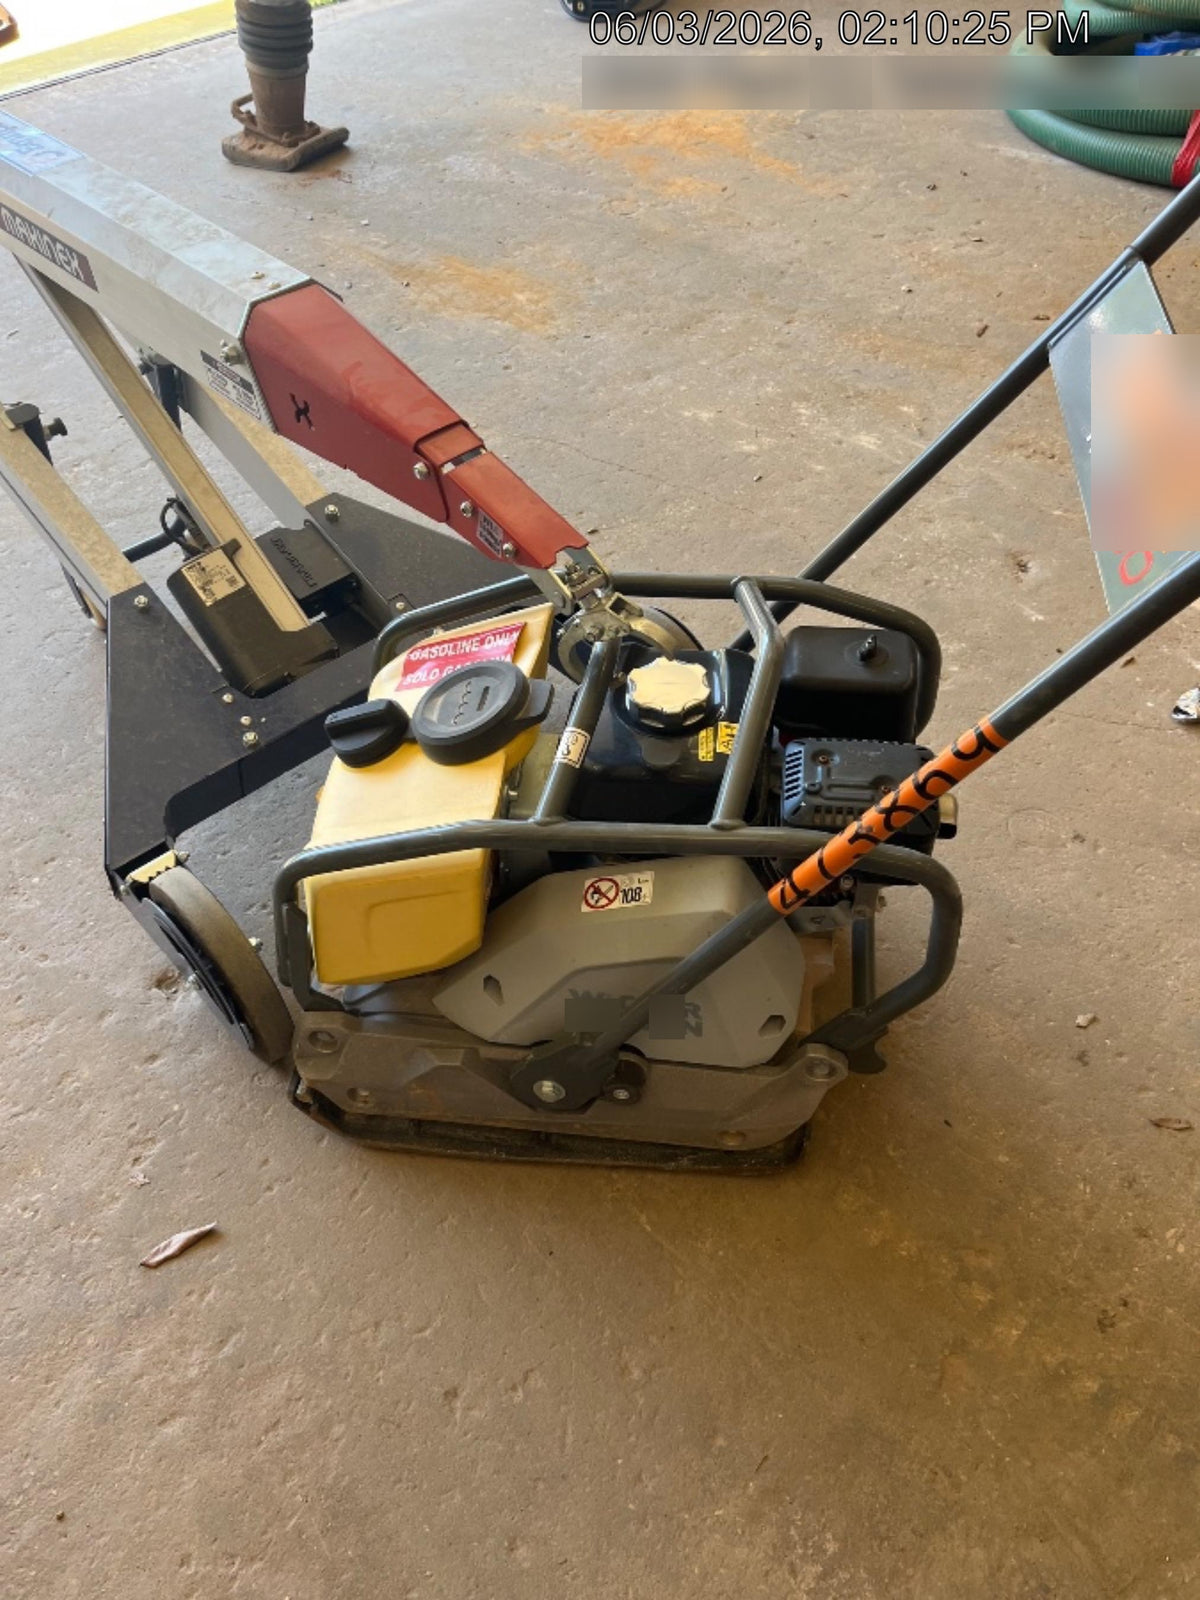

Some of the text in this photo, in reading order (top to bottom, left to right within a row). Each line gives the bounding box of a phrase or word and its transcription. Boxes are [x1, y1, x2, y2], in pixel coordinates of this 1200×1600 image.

[407, 631, 521, 662] GASOLINE ONLY
[402, 668, 440, 687] SOLO
